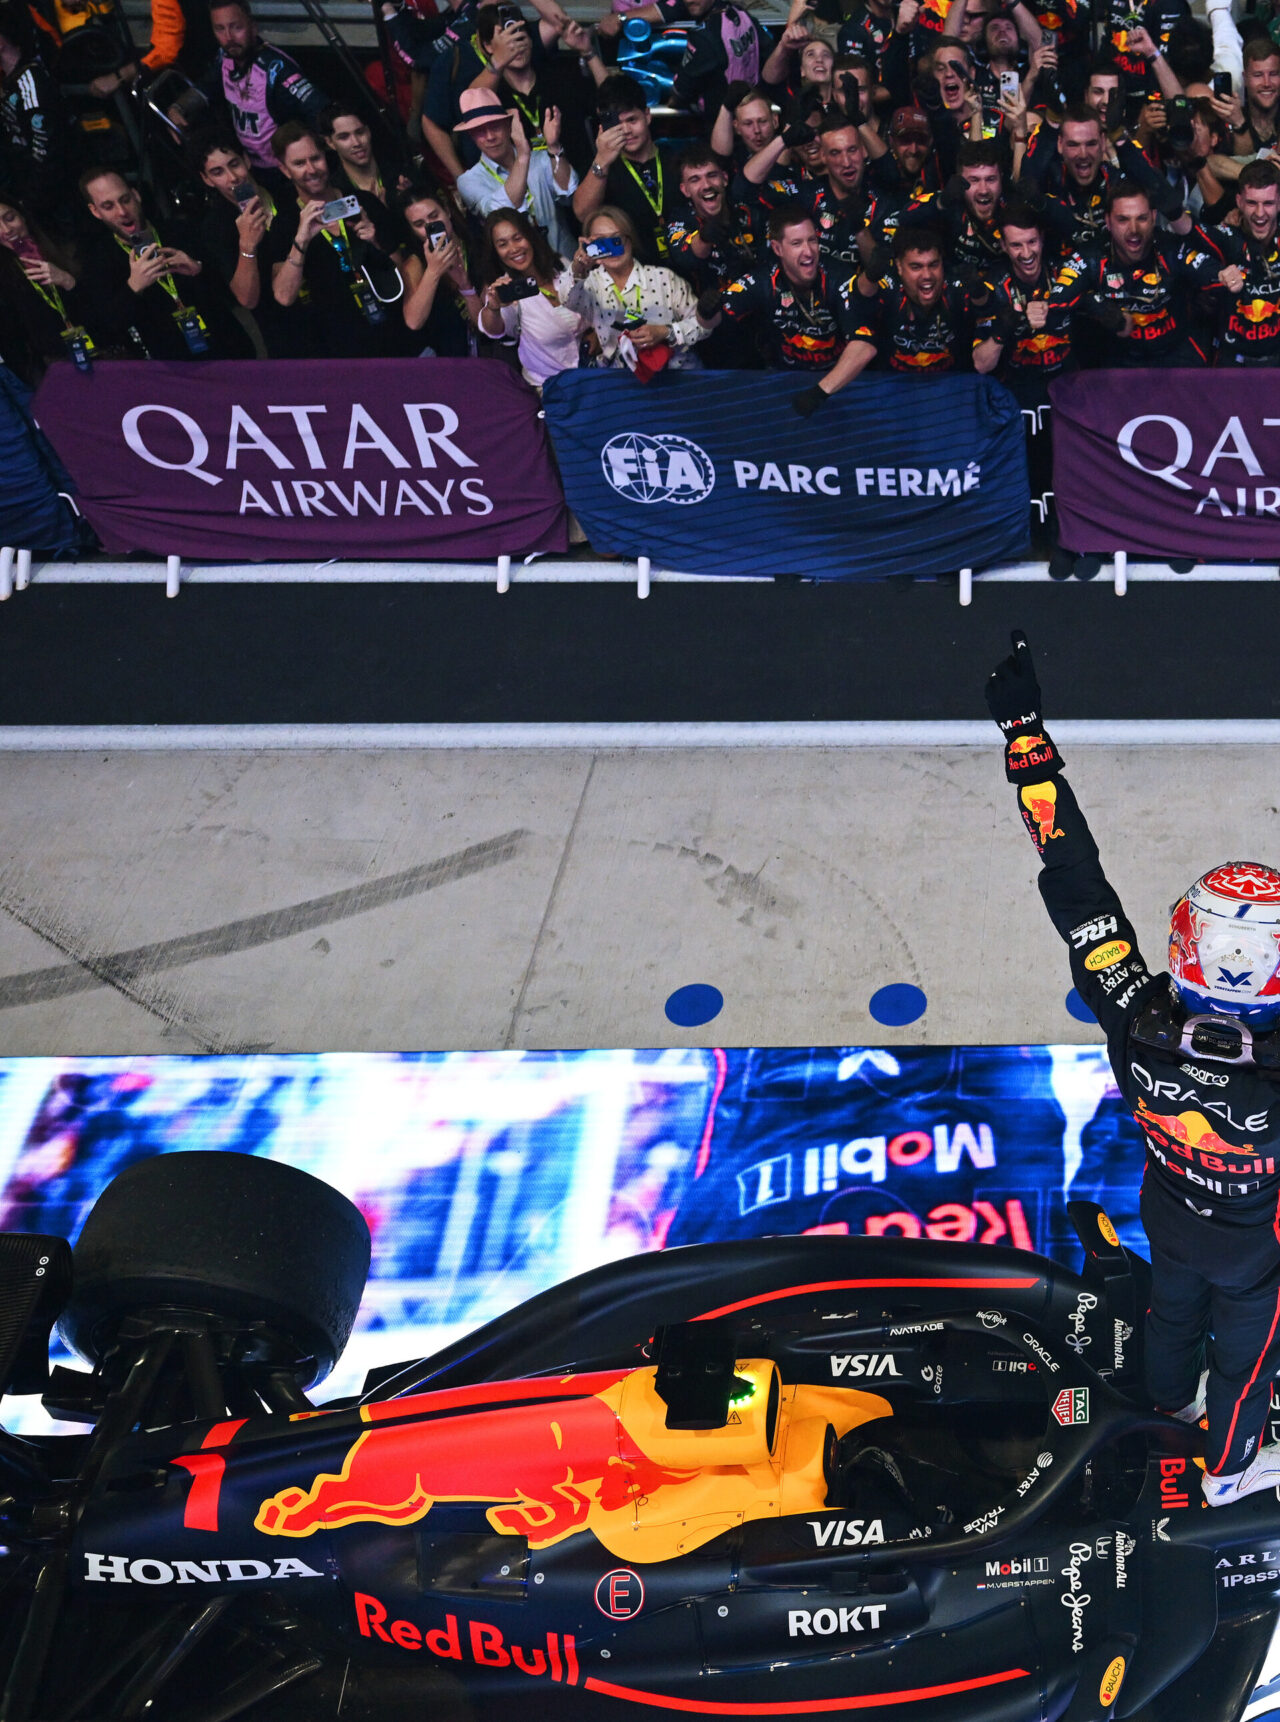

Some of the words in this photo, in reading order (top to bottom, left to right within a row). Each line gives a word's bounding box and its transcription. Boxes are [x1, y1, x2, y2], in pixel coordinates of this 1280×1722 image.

[121, 403, 479, 485] QATAR
[734, 460, 841, 496] PARC
[856, 462, 981, 497] FERMÉ
[239, 478, 494, 517] AIRWAYS
[1001, 711, 1037, 732] Mobil
[1009, 754, 1029, 771] Red
[1029, 746, 1054, 768] Bull
[1072, 916, 1118, 949] HRC
[1089, 946, 1120, 967] RAUCH
[1102, 967, 1129, 996] AT&T
[1180, 1063, 1229, 1087] sparco
[1131, 1062, 1269, 1132] ORACLE
[804, 1123, 996, 1195] Mobil
[1146, 1136, 1222, 1194] Mobil
[1200, 1152, 1275, 1174] Bull
[1100, 1216, 1113, 1240] RAUCH
[890, 1322, 944, 1336] AVATRADE
[976, 1310, 990, 1321] Hard
[990, 1314, 1007, 1327] Rock
[1069, 1293, 1097, 1335] Pepe
[830, 1354, 902, 1377] VISA
[1008, 1360, 1037, 1373] obil
[1023, 1333, 1060, 1372] ORACLE
[934, 1365, 943, 1394] Gate
[1056, 1391, 1070, 1423] HEUER
[1075, 1390, 1086, 1421] TAG
[1016, 1466, 1041, 1497] AT&T
[1160, 1457, 1189, 1509] Bull
[806, 1519, 885, 1547] VISA
[963, 1505, 1006, 1533] TRADE
[975, 1517, 999, 1534] AVA
[84, 1552, 324, 1585] HONDA
[986, 1558, 1030, 1577] Mobil
[1061, 1542, 1092, 1593] Pepe
[609, 1575, 631, 1614] E
[986, 1578, 1055, 1590] M.VERSTAPPEN
[788, 1604, 887, 1636] ROKT
[1061, 1593, 1091, 1653] Jeans
[354, 1592, 462, 1661] Red
[469, 1620, 580, 1686] Bull
[1106, 1661, 1123, 1695] RAUCH
